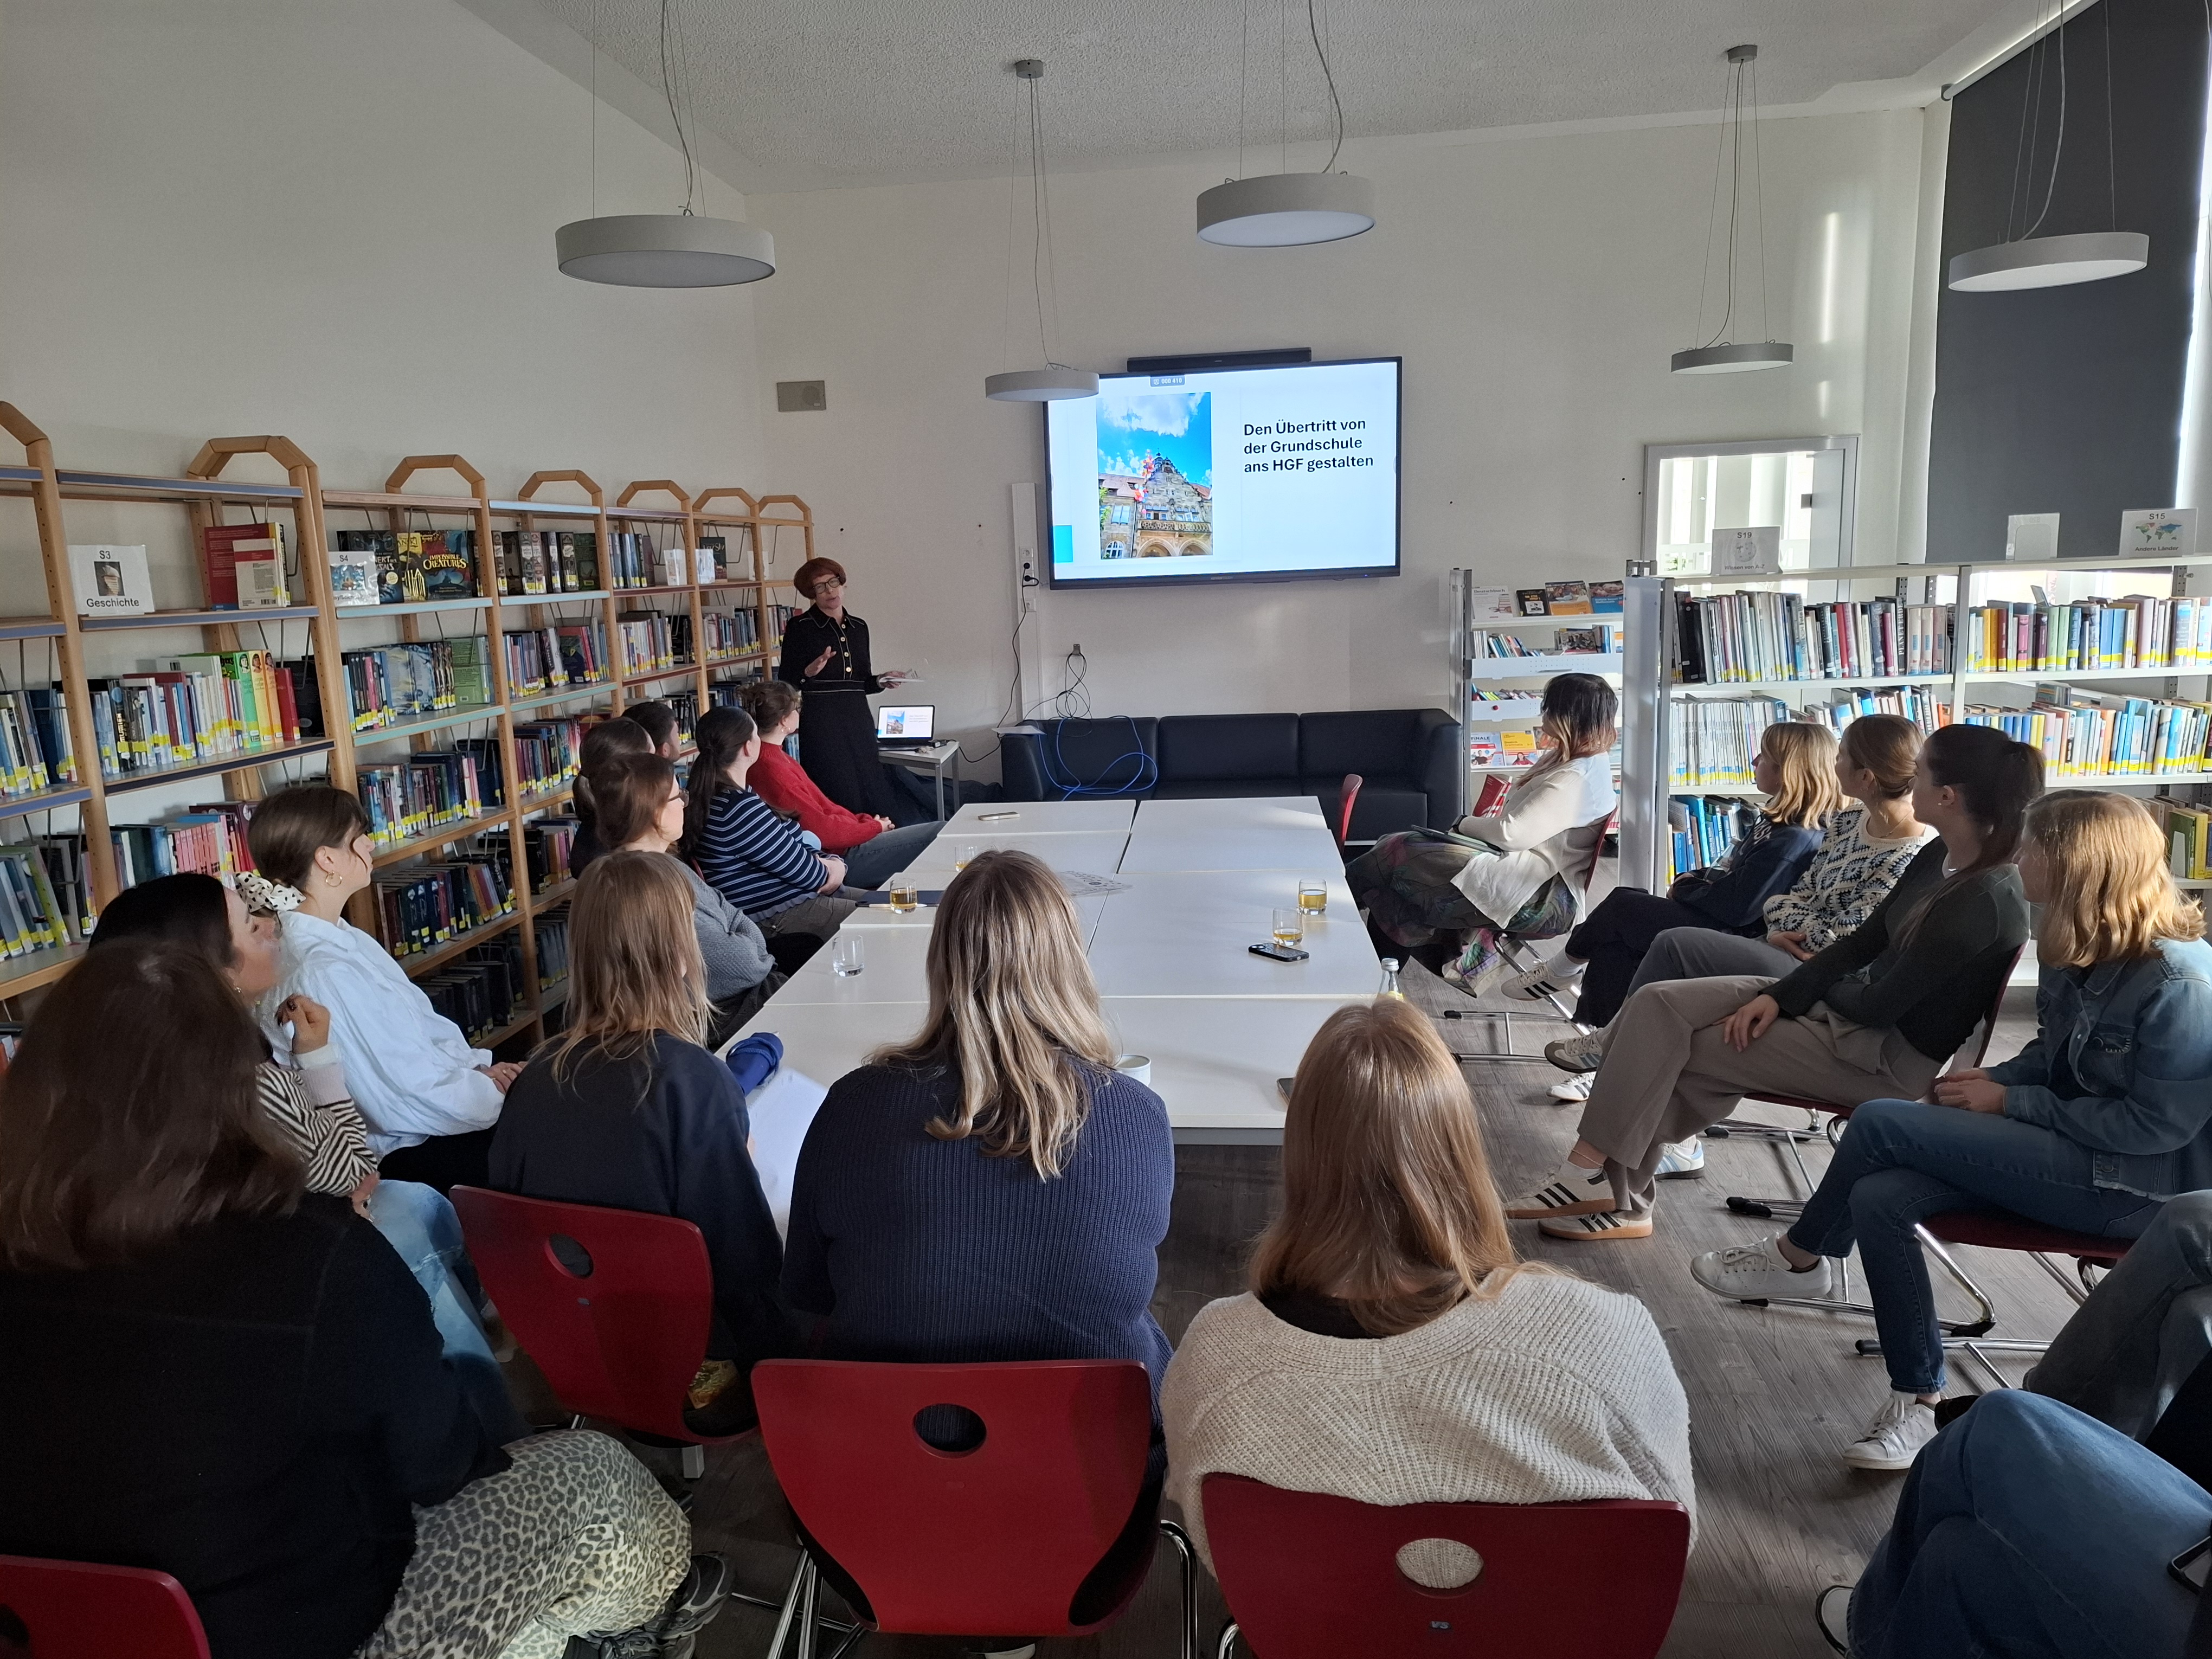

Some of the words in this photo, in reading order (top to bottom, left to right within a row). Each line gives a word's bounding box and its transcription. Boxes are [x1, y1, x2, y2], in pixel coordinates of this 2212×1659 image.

[1244, 424, 1272, 436] Den
[1276, 419, 1337, 434] Übertritt
[1340, 420, 1366, 430] von
[1244, 442, 1267, 454] der
[1270, 437, 1362, 453] Grundschule
[1244, 462, 1269, 472] ans
[1273, 458, 1304, 471] HGF
[1307, 455, 1373, 472] gestalten
[99, 550, 111, 560] S3
[423, 558, 467, 570] CREATURES
[86, 598, 140, 607] Geschichte
